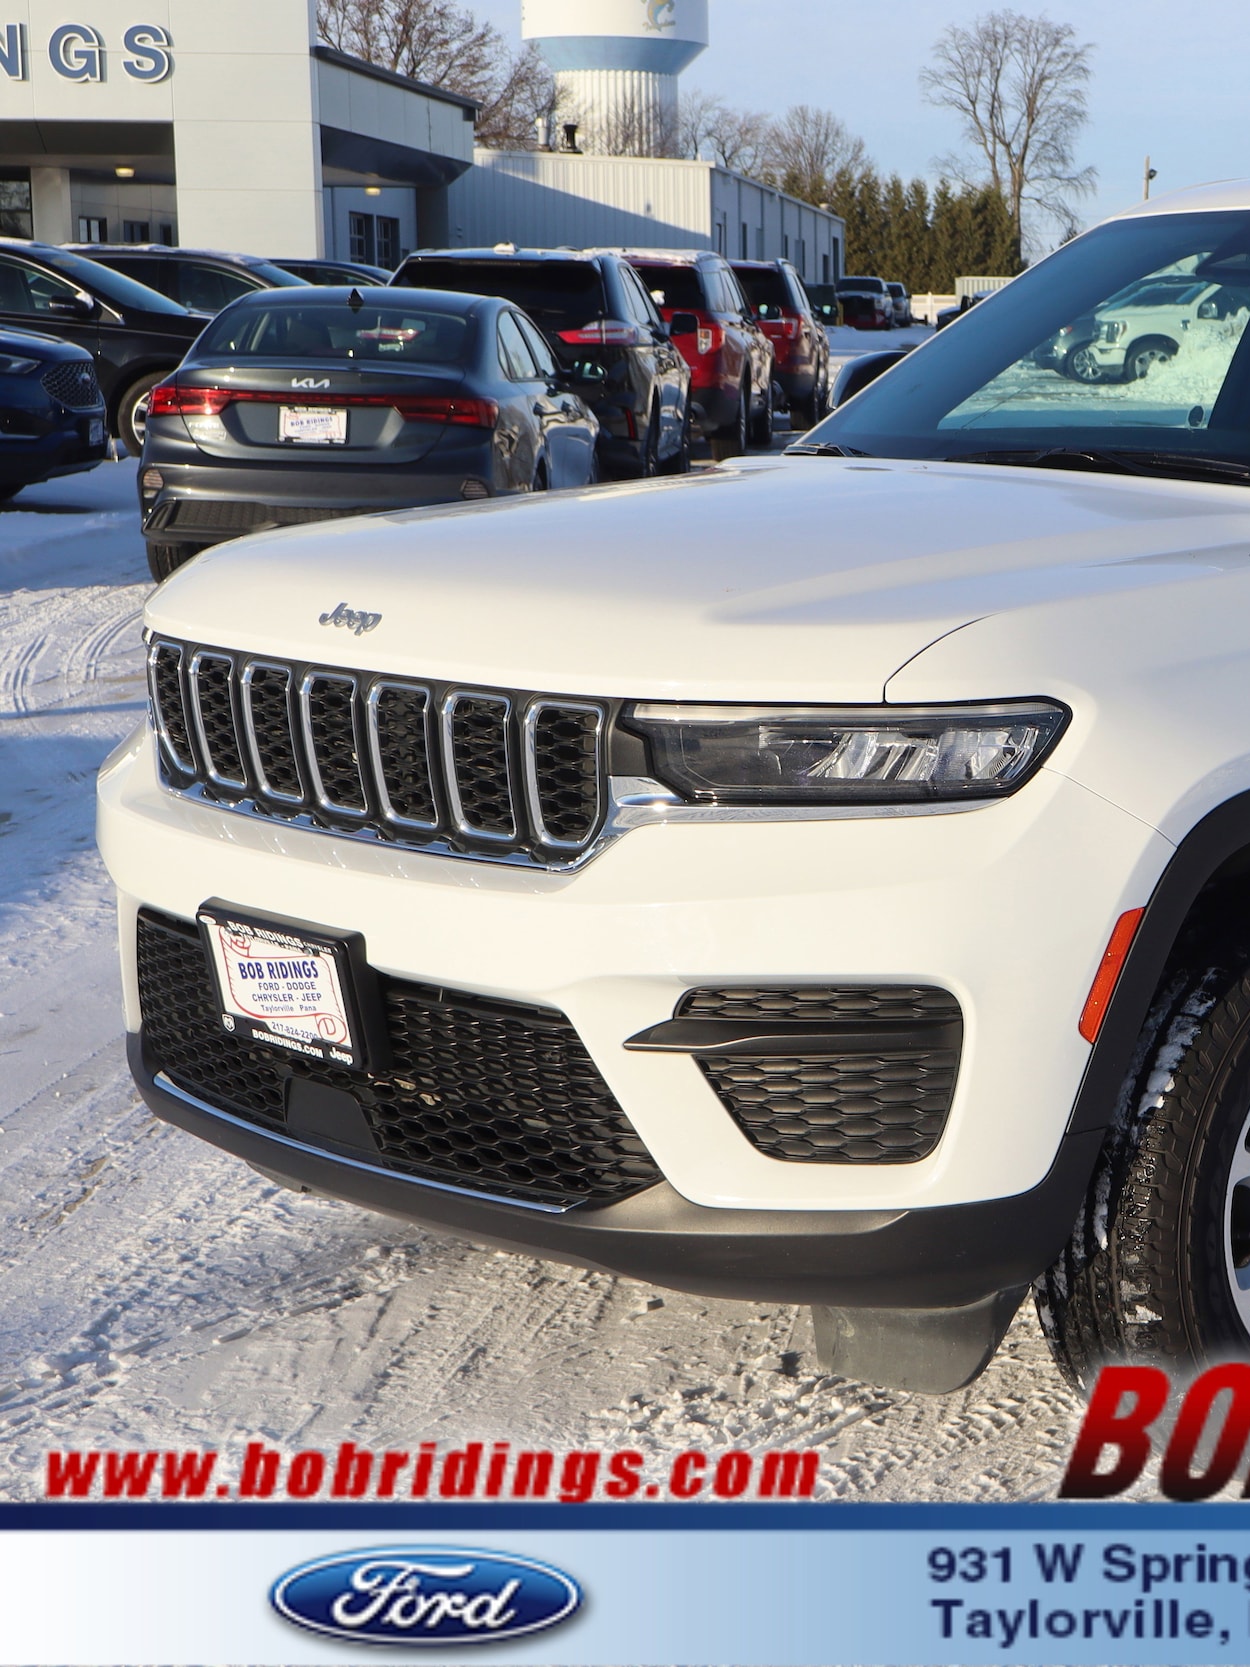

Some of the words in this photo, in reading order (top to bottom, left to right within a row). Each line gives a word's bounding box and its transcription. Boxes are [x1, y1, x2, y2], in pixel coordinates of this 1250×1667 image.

[319, 602, 382, 636] Jeep
[227, 920, 254, 936] BOB
[253, 927, 304, 949] RIDINGS
[238, 961, 265, 979] BOB
[266, 960, 319, 979] RIDINGS
[258, 982, 280, 991] FORD
[286, 981, 317, 991] DODGE
[251, 993, 295, 1002] CHRYSLER
[301, 992, 322, 1002] JEEP
[260, 1004, 294, 1013] Taylorville
[299, 1004, 317, 1012] Pana
[251, 1028, 324, 1059] BOBRIDINGS.COM
[329, 1046, 353, 1065] Jeep
